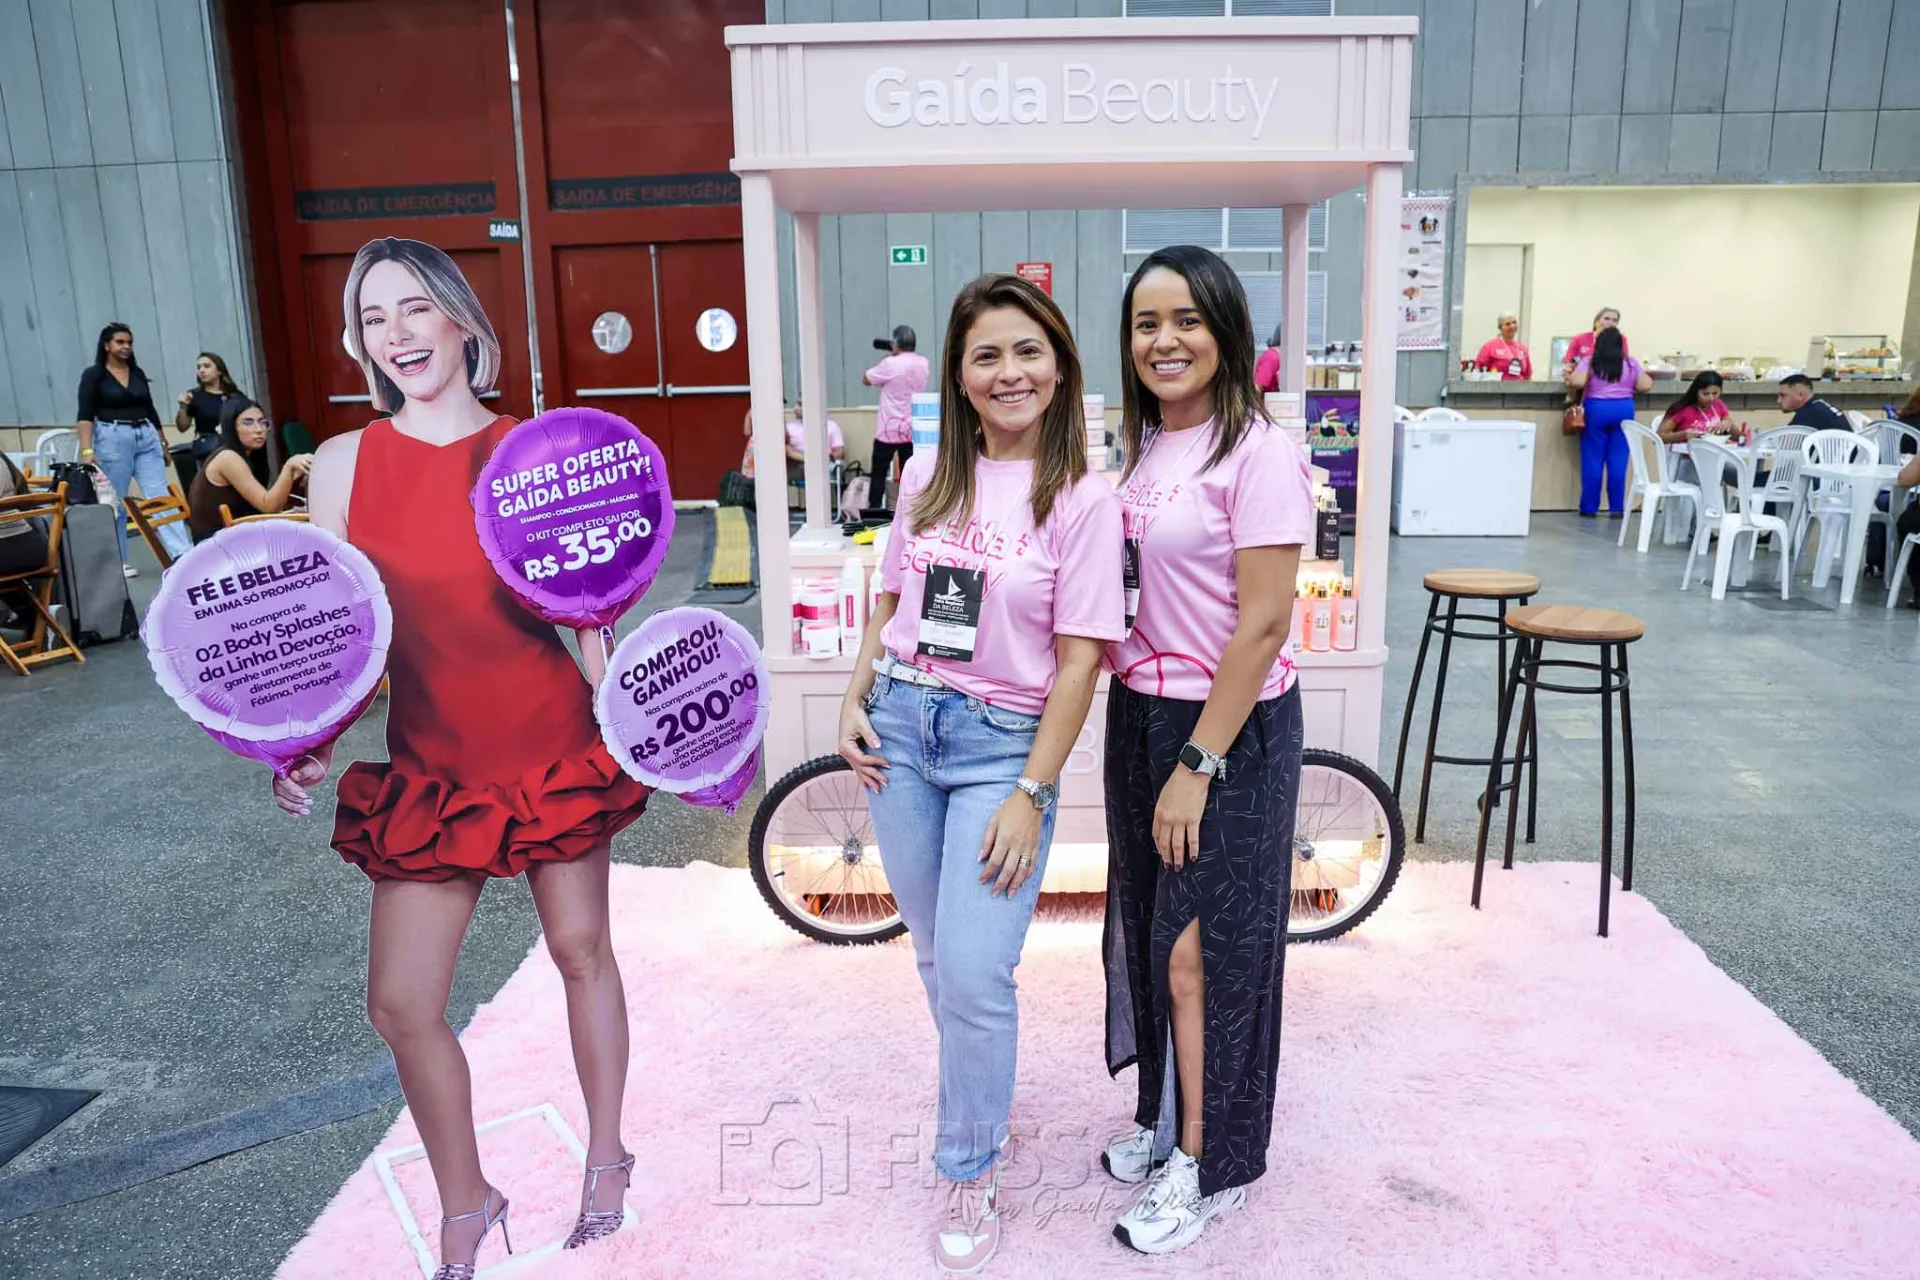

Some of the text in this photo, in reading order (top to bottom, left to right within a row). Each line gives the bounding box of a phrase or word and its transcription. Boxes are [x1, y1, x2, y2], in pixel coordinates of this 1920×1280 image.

[864, 60, 1279, 139] Gaída Beauty
[612, 187, 635, 201] DE
[489, 221, 520, 239] SAÍDA
[491, 438, 640, 498] SUPER OFERTA
[498, 455, 652, 518] GAÍDA BEAUTY!
[519, 492, 640, 524] SHAMPOO CONDICIONADOR MÁSCARA
[526, 509, 642, 543] O KIT COMPLETO SAI POR
[523, 517, 652, 581] R$ 35,00
[187, 551, 330, 606] FÉ E BELEZA
[194, 571, 331, 620] EM UMA SÓ PROMOÇÃO!
[195, 605, 351, 663] 02 Body Splashes
[230, 601, 307, 633] Na compra de
[199, 622, 362, 683] da Linha Devoção,
[224, 642, 348, 692] ganhe um terço trazido
[249, 660, 332, 695] diretamente de
[619, 620, 723, 690] COMPROU,
[633, 640, 721, 706] GANHOU!
[250, 669, 342, 708] Fátima, Portugal!
[644, 671, 729, 718] Nas compras acima de
[629, 672, 758, 764] R$ 200,00
[672, 717, 736, 756] ganhe uma blusa
[660, 719, 753, 771] ou uma ecobag exclusiva
[679, 758, 691, 769] da
[714, 731, 743, 751] Beauty!
